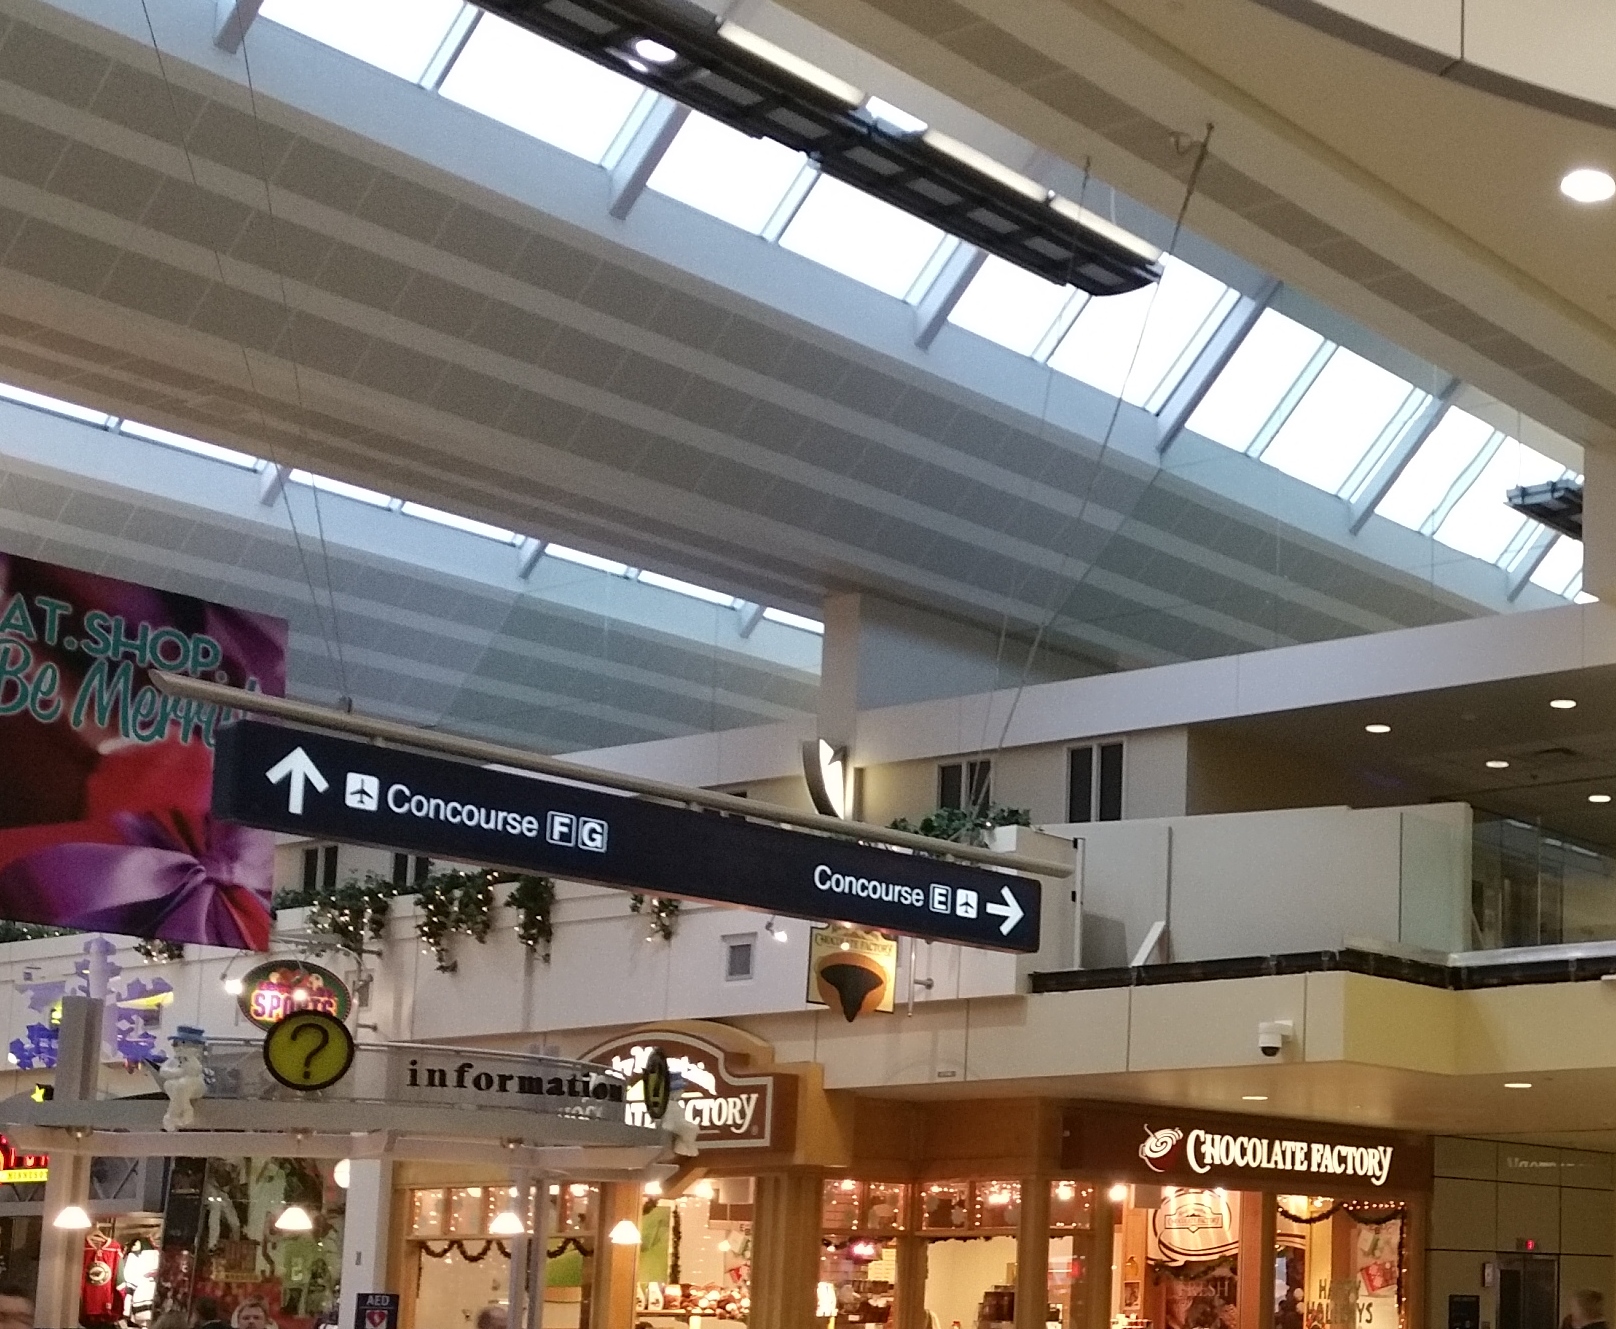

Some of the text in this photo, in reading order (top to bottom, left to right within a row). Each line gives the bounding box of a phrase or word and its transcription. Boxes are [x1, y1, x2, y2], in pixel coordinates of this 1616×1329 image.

[0, 637, 62, 723] Be
[387, 784, 605, 850] Concourse F G
[814, 864, 949, 912] Concourse E
[407, 1059, 623, 1102] information
[1187, 1129, 1393, 1186] CHOCOLATE FACTORY
[367, 1295, 390, 1306] AED
